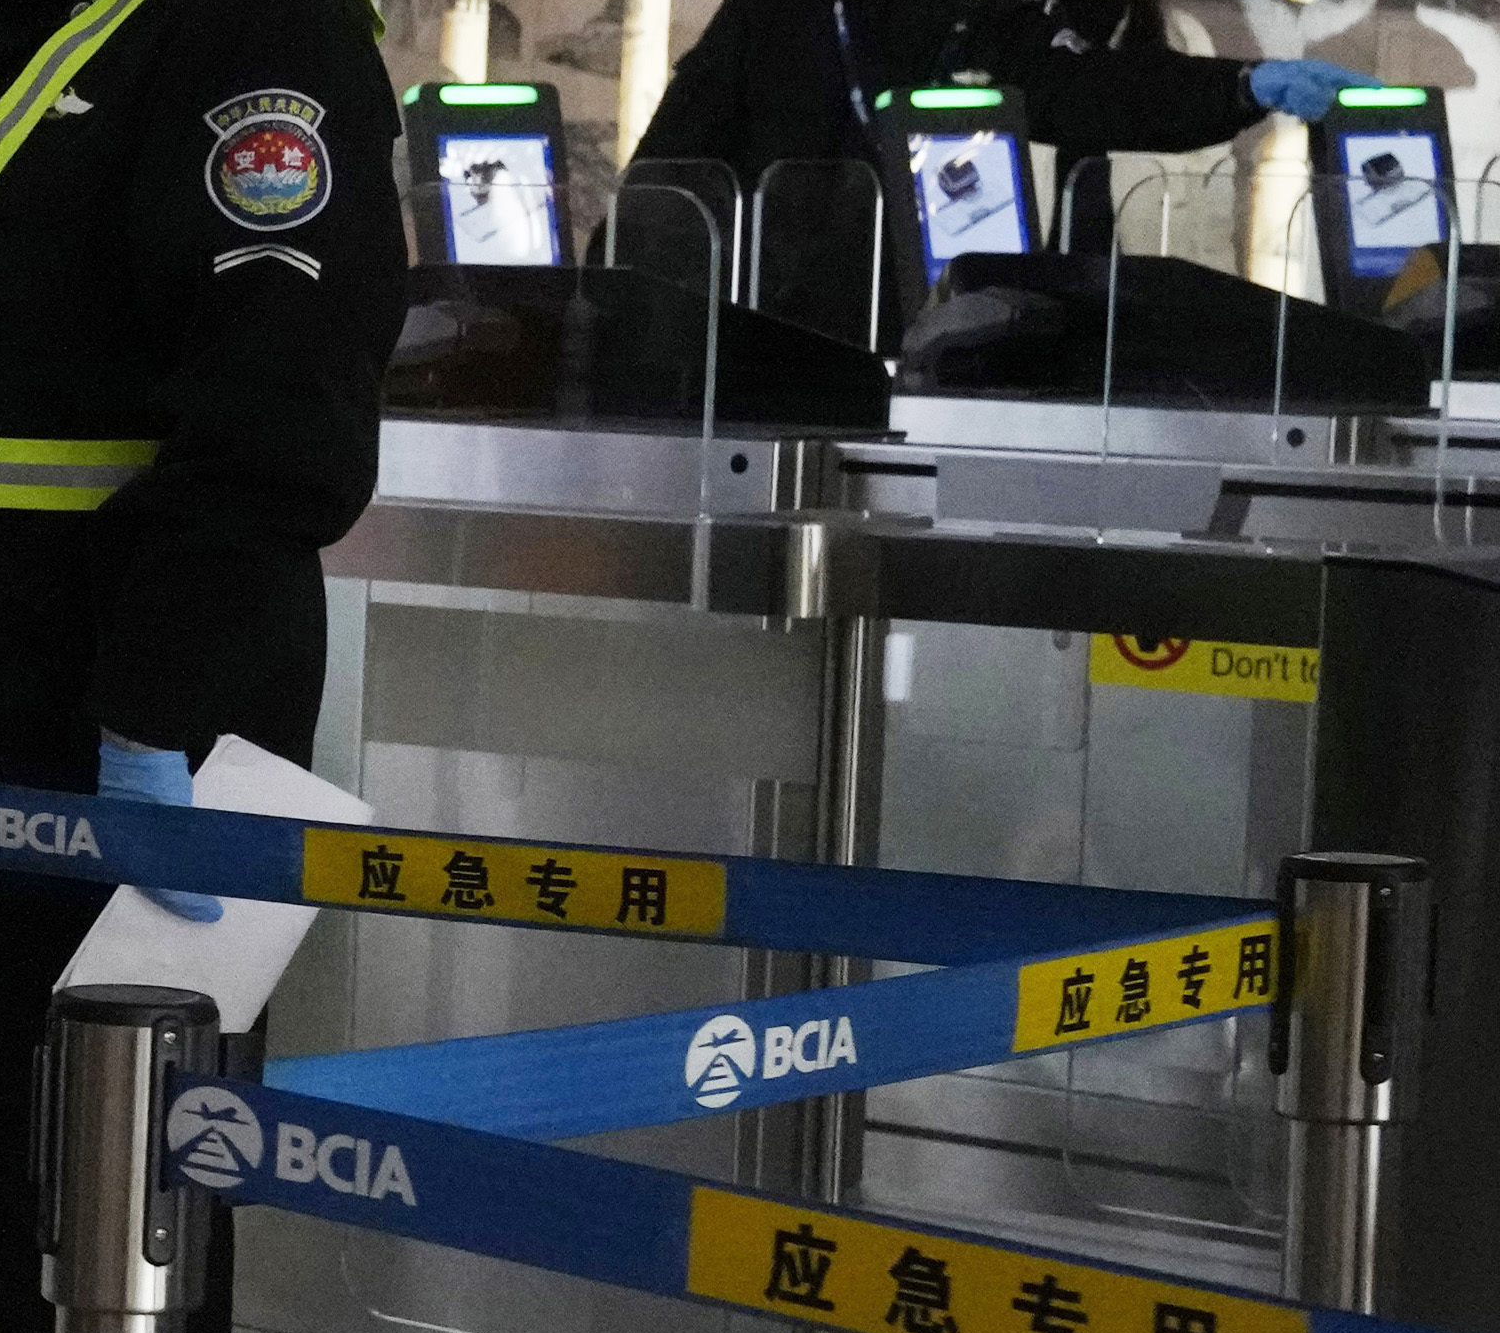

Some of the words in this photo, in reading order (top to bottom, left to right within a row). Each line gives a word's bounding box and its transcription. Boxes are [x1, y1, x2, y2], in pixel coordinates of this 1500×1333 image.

[1211, 647, 1288, 682] Don't
[357, 843, 669, 927] 应急专用
[1053, 932, 1273, 1037] 应急专用
[761, 1014, 858, 1081] BCIA
[275, 1132, 418, 1207] BCIA
